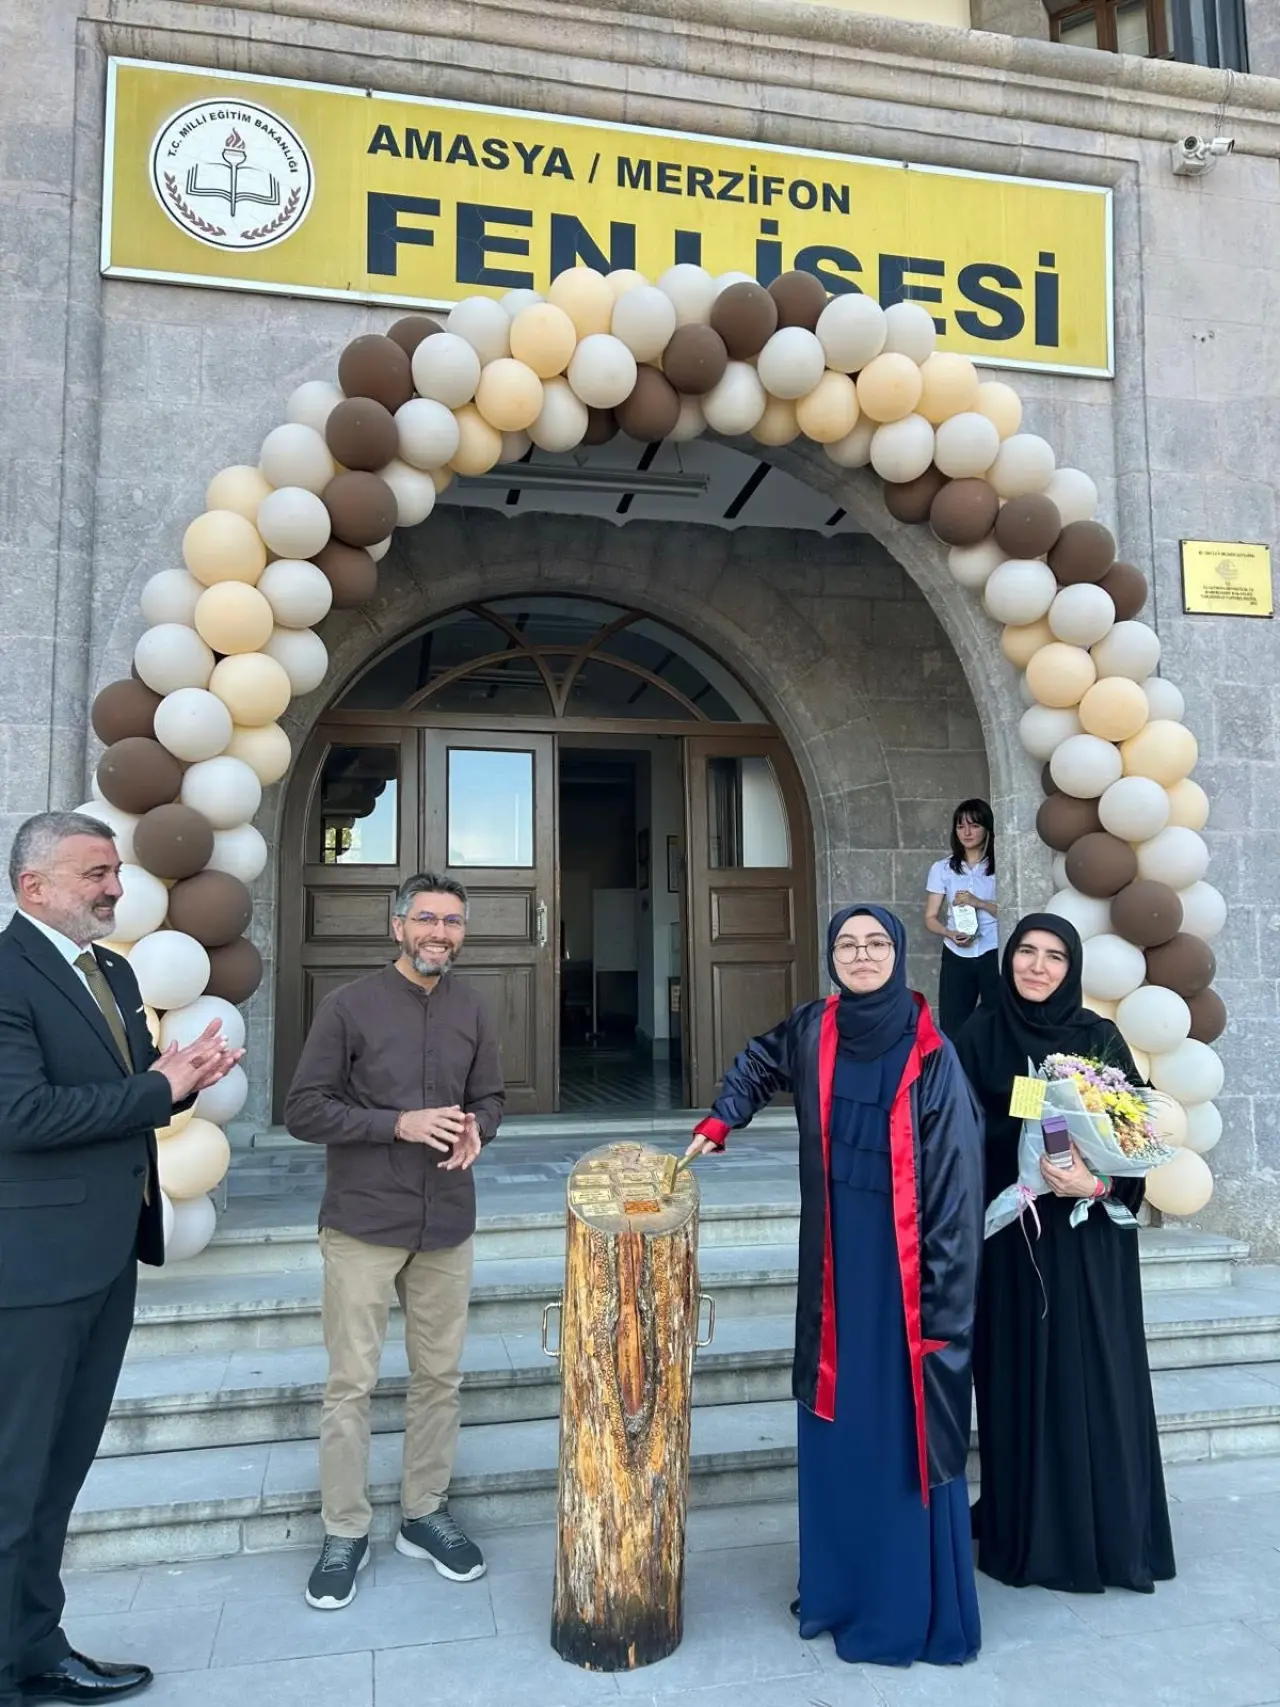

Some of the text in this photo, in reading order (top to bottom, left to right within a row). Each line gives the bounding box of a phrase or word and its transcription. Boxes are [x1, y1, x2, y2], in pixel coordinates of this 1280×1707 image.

[167, 110, 298, 173] T.C. MİLLİ EĞİTİM BAKANLIĞI
[367, 124, 851, 214] AMASYA / MERZİFON
[367, 191, 636, 290] FEN
